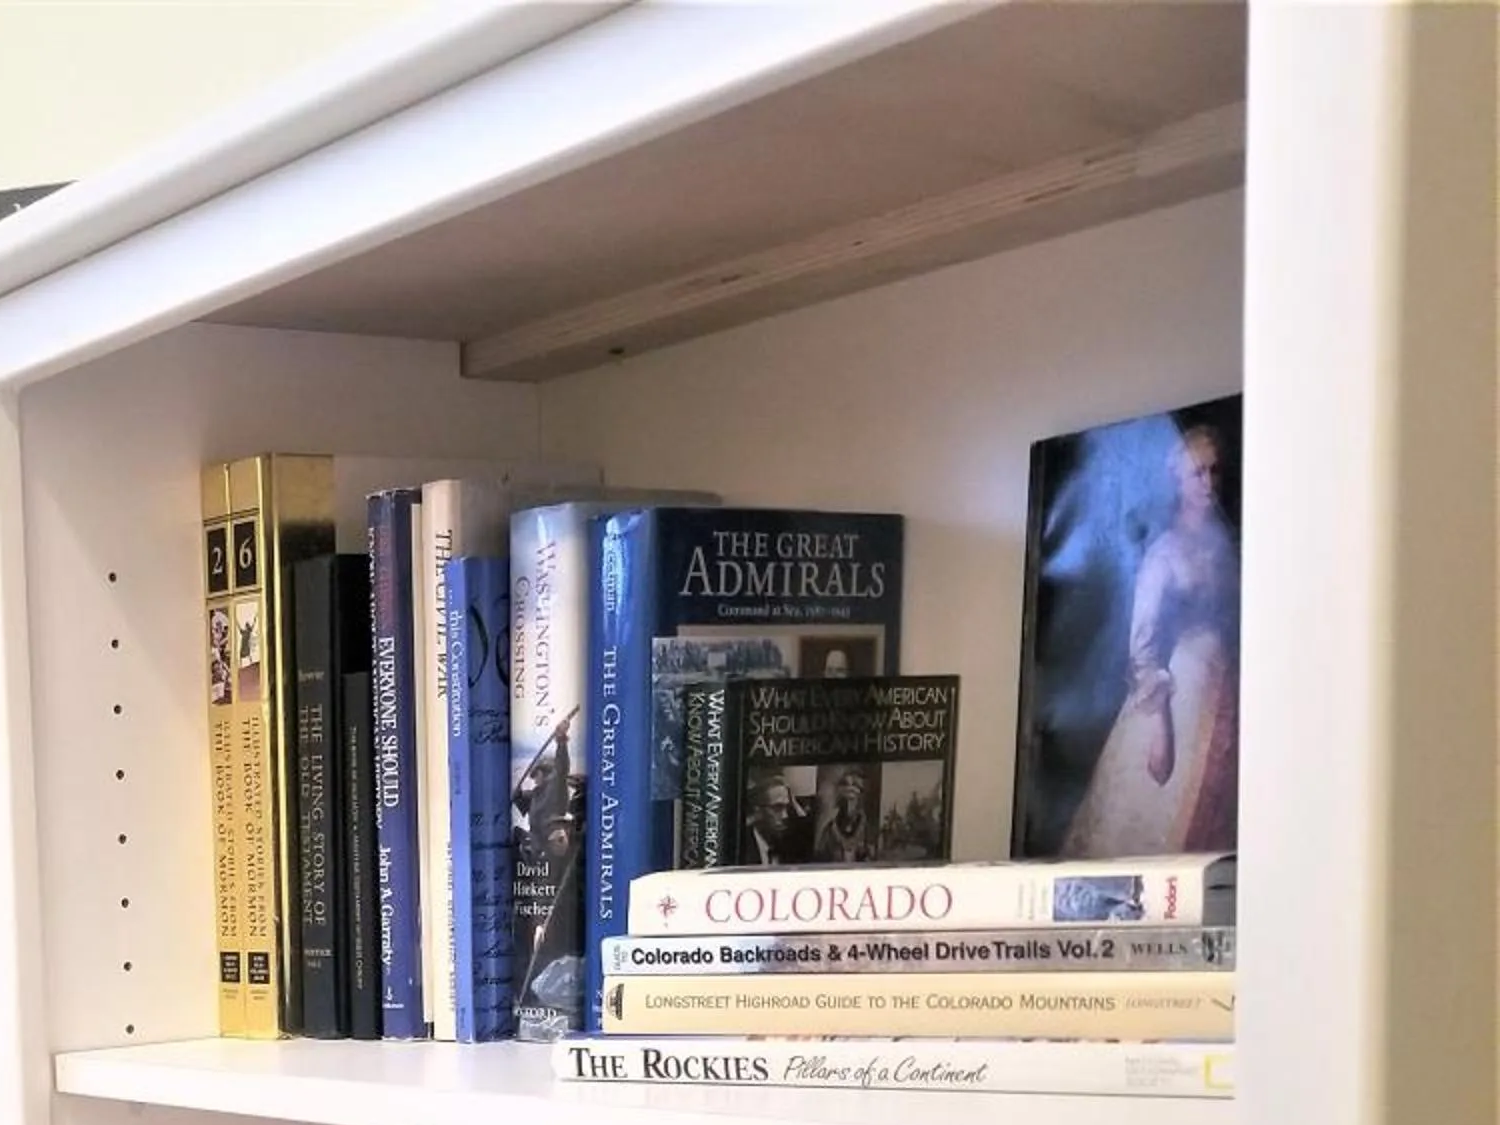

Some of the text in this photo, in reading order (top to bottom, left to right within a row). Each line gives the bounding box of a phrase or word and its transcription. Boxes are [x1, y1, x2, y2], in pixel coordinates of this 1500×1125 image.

[211, 547, 223, 575] 2
[239, 537, 252, 569] 6
[713, 531, 859, 559] THE GREAT
[679, 546, 885, 598] ADMIRALS
[515, 576, 531, 700] CROSSING
[533, 541, 558, 729] WASHINGTON'S
[378, 637, 398, 730] EVERYONE
[450, 641, 465, 737] Constitution
[602, 647, 617, 697] THE
[751, 687, 805, 709] WHAT
[867, 686, 947, 706] AMERICAN
[888, 707, 947, 729] ABOUT
[299, 705, 310, 743] THE
[602, 703, 621, 789] GREAT
[750, 732, 945, 758] AMERICAN HISTORY
[382, 735, 399, 807] SHOULD
[684, 693, 704, 869] KNOW ABOUT AMERICA
[704, 690, 724, 869] WHAT EVERY AMERICAN
[215, 721, 230, 937] THE BOOK OF MORMON
[241, 719, 258, 937] THE BOOK OF MORMON
[311, 704, 326, 925] THE LIVING STORY OF
[301, 813, 313, 925] TESTAMENT
[379, 844, 392, 882] John
[516, 861, 549, 877] David
[600, 792, 618, 919] ADMIRALS
[513, 881, 556, 897] Hackett
[515, 901, 554, 916] Fischer
[705, 883, 953, 923] COLORADO
[381, 904, 394, 965] Garraty
[631, 939, 713, 965] Colorado
[720, 937, 820, 964] Backroads
[828, 939, 842, 962] &
[847, 938, 929, 962] 4-Wheel
[936, 937, 990, 961] Drive
[993, 935, 1051, 960] Trails
[1057, 935, 1097, 959] Vol.
[1101, 938, 1115, 958] 2
[1131, 942, 1188, 956] WELLS
[645, 993, 1115, 1011] LONGSTREET HIGHROAD GUIDE TO THE COLORADO MOUNTAINS
[569, 1048, 987, 1088] THE ROCKIES Pillars of a Continent
